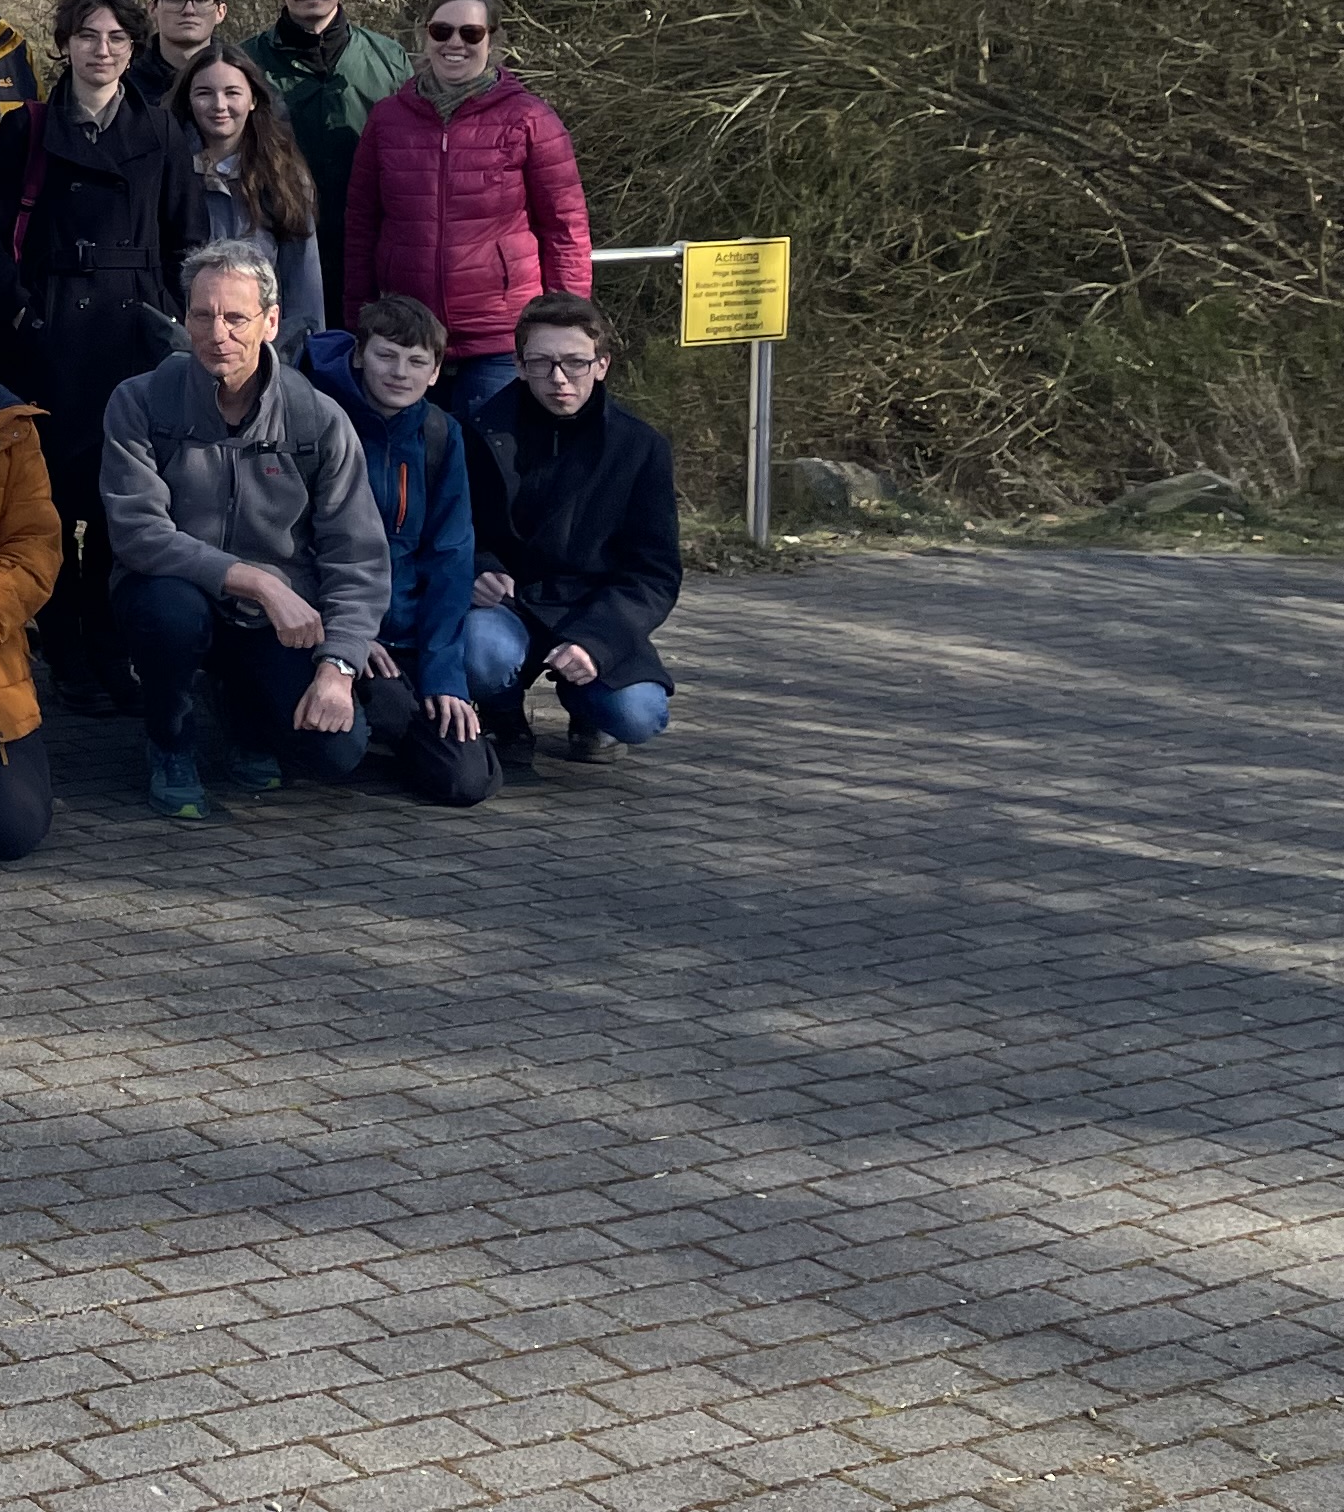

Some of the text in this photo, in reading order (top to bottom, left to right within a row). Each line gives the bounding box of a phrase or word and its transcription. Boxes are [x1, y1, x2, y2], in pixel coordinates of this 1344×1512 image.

[715, 252, 759, 264] Achtung
[710, 311, 758, 322] Betreten auf
[734, 321, 763, 332] Gefahr!
